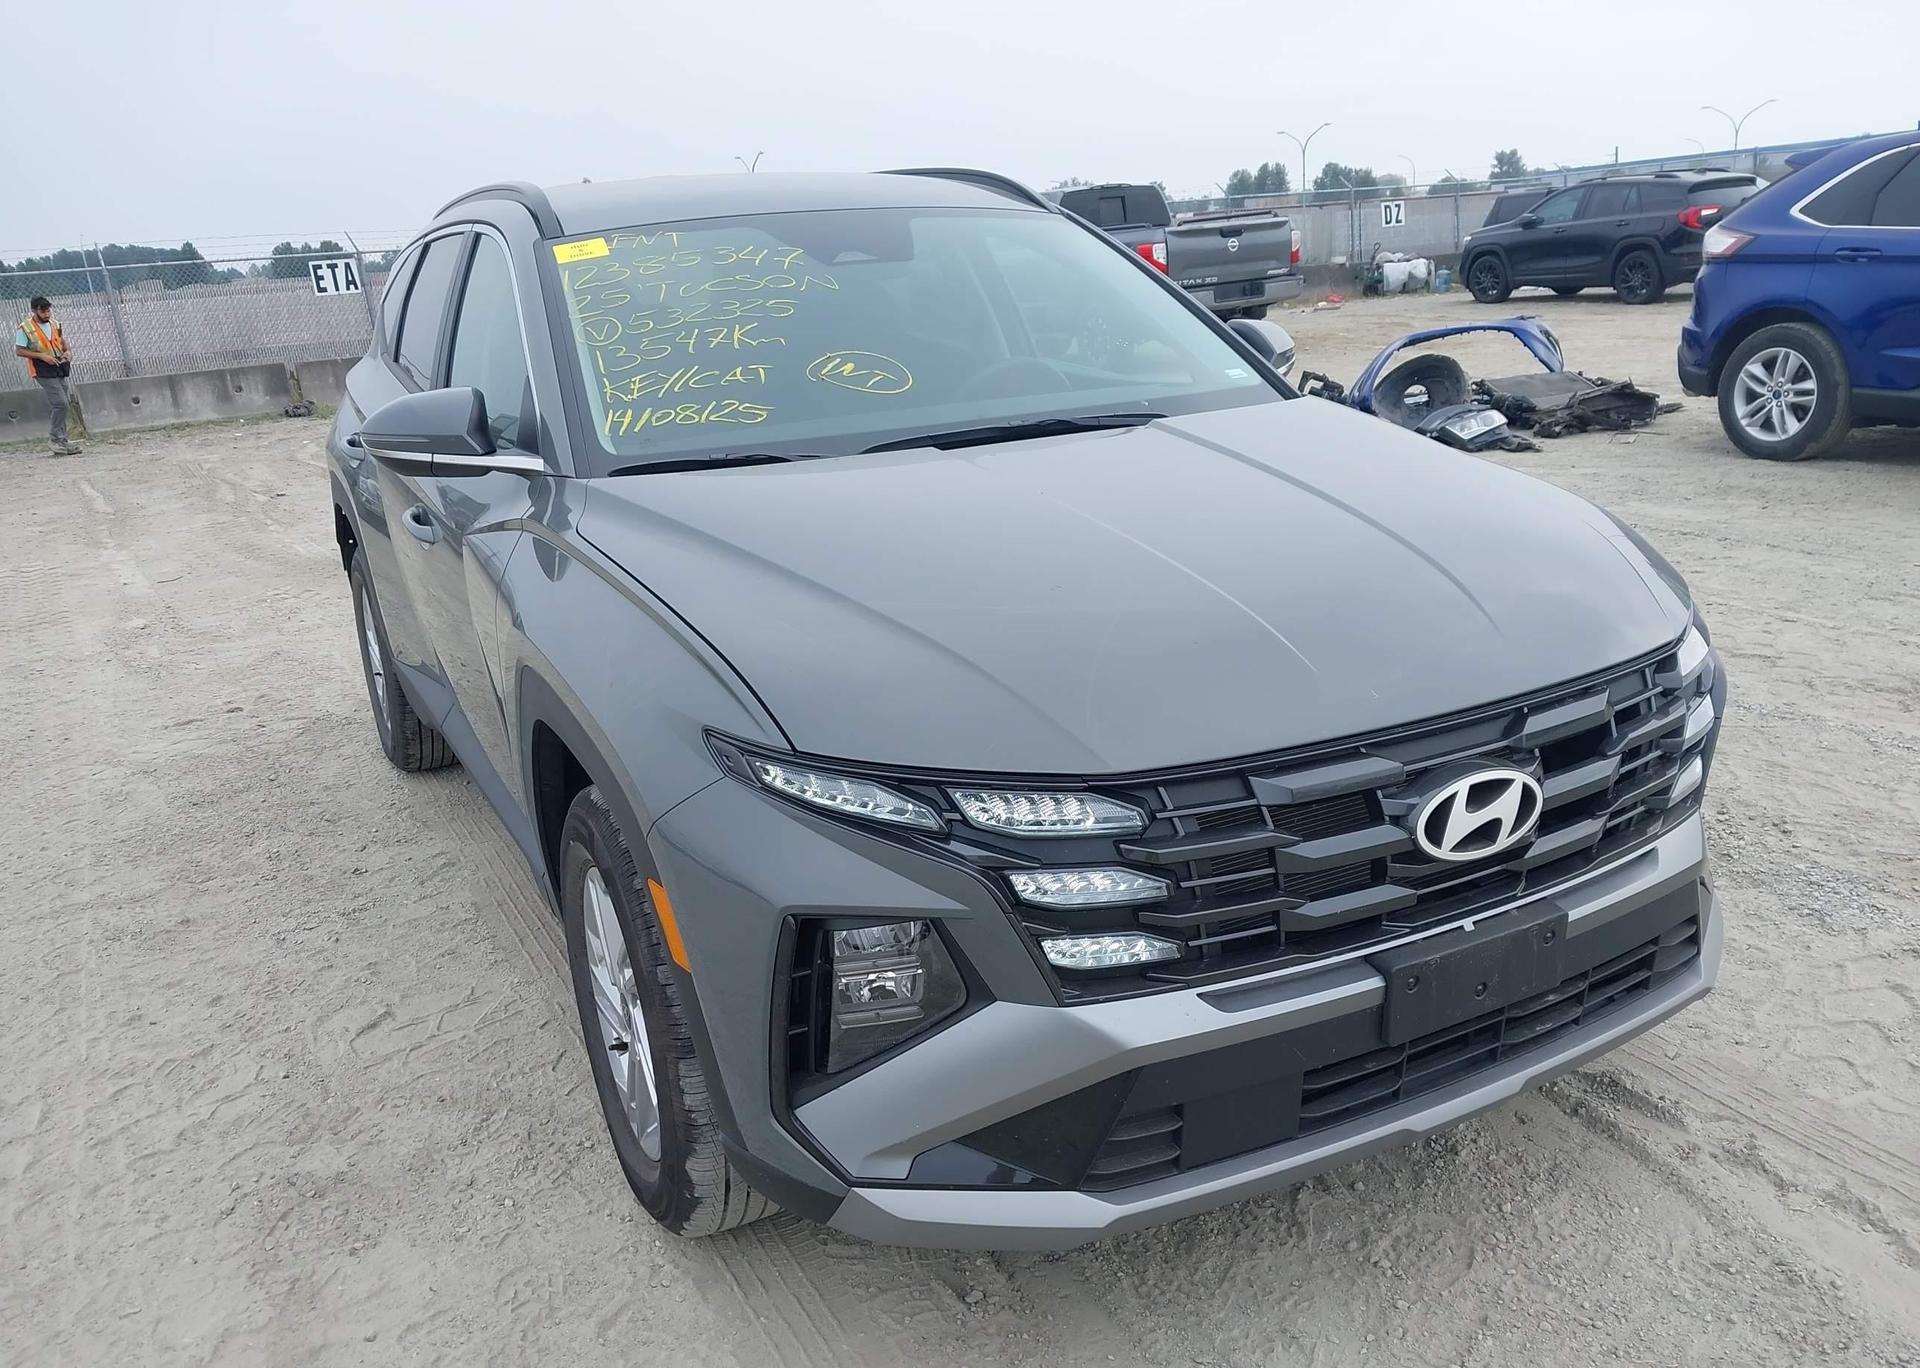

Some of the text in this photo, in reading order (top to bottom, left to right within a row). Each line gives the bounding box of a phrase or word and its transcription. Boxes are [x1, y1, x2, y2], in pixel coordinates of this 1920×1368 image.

[1384, 203, 1402, 225] DZ
[311, 261, 359, 293] ETA
[1175, 278, 1202, 286] ITAN
